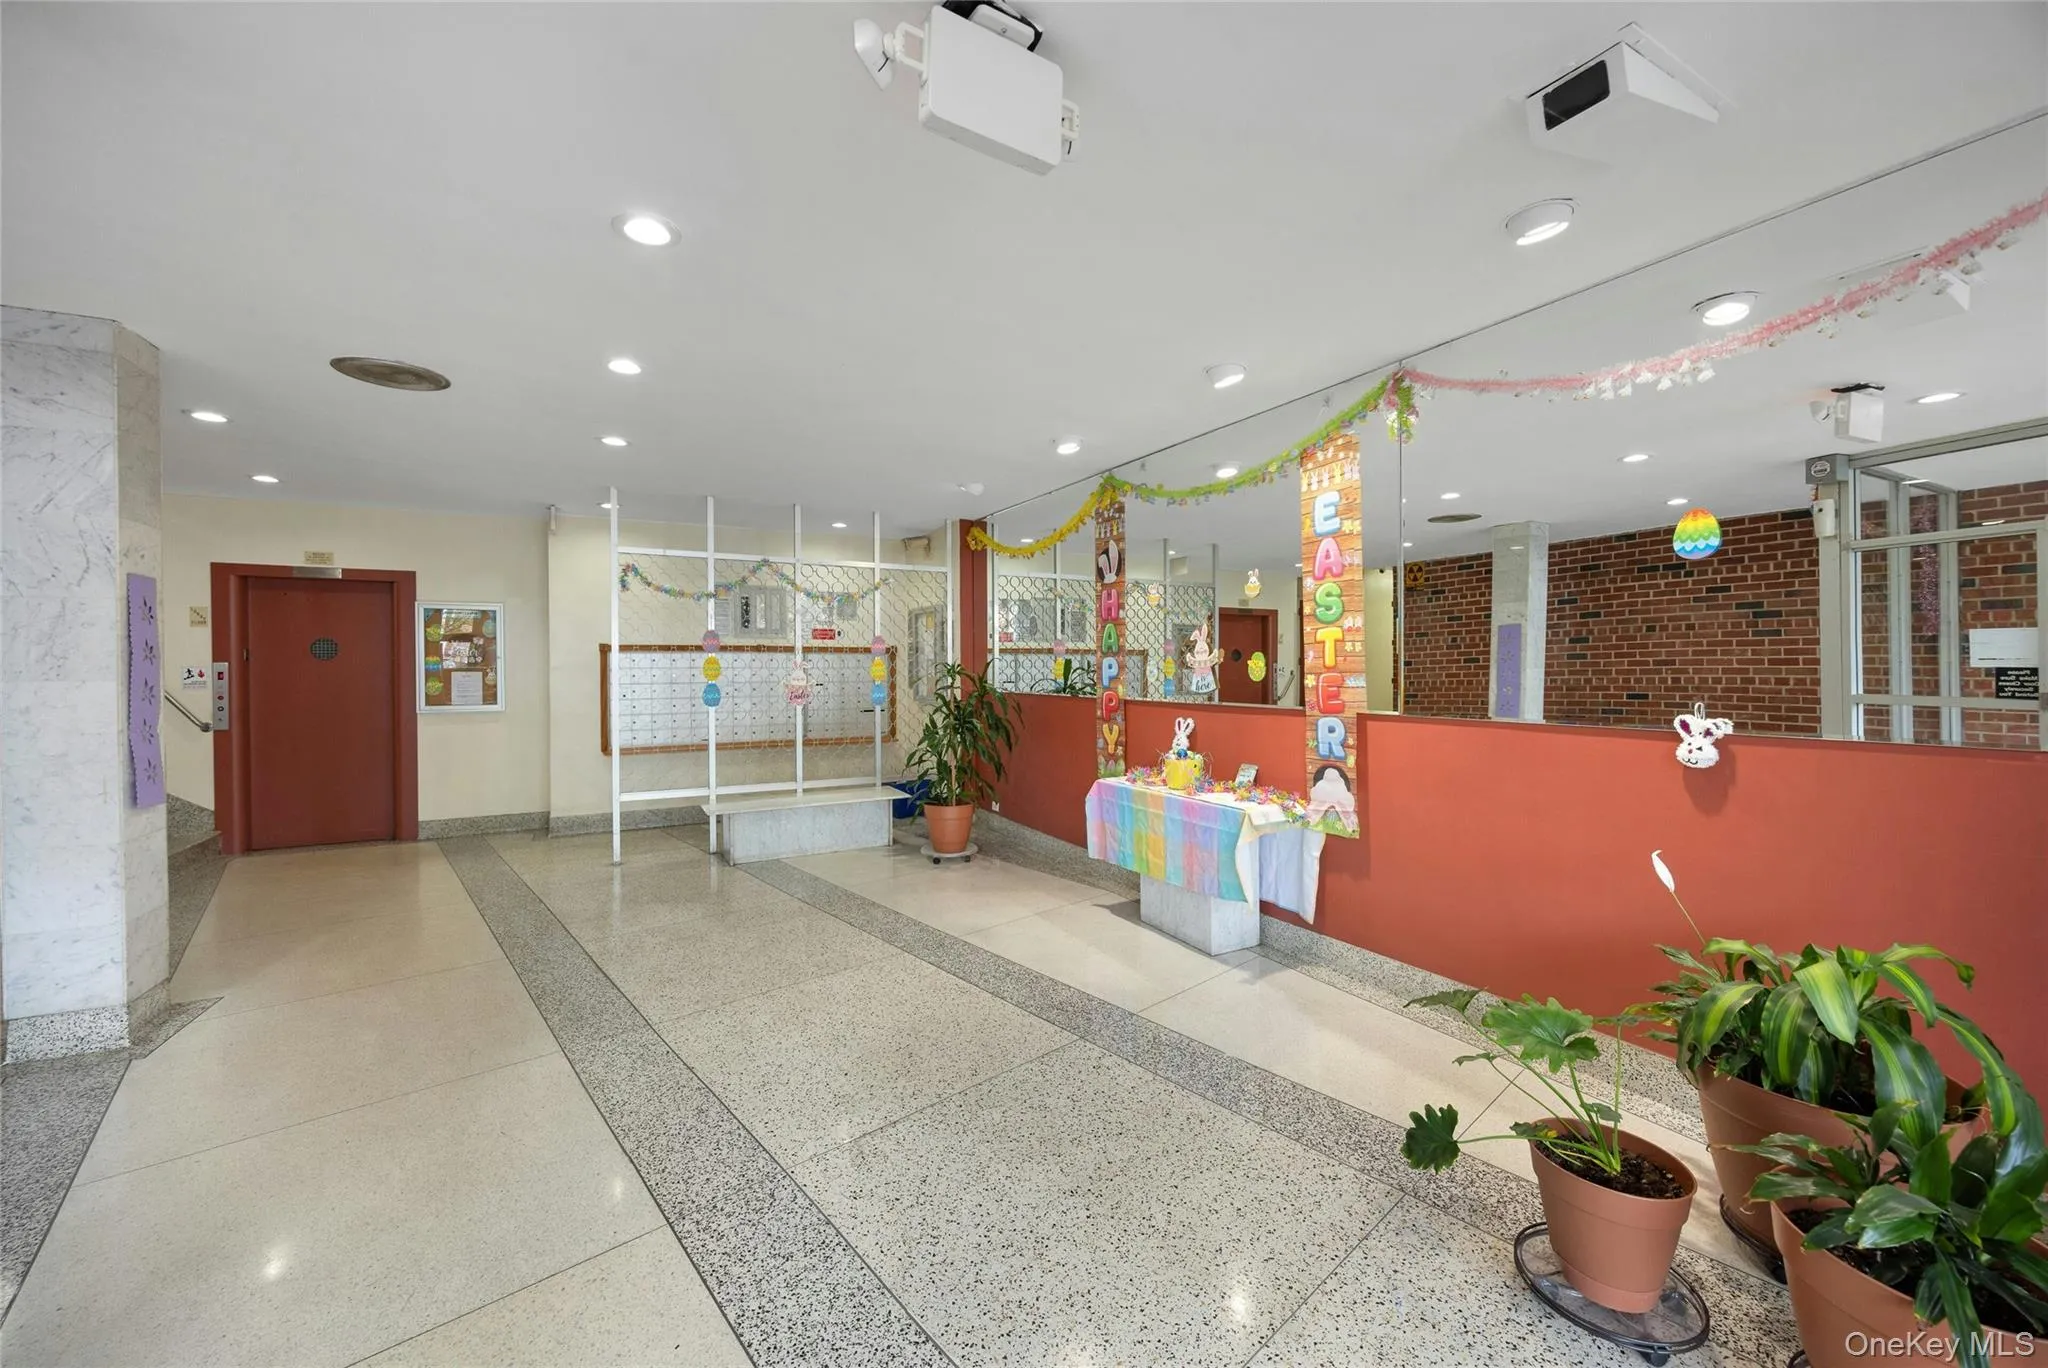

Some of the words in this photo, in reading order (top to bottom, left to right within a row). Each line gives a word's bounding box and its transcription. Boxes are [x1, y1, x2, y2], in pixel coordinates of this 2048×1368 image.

[1101, 588, 1121, 755] HAPPY
[1195, 680, 1210, 691] here
[1313, 490, 1346, 760] EASTER
